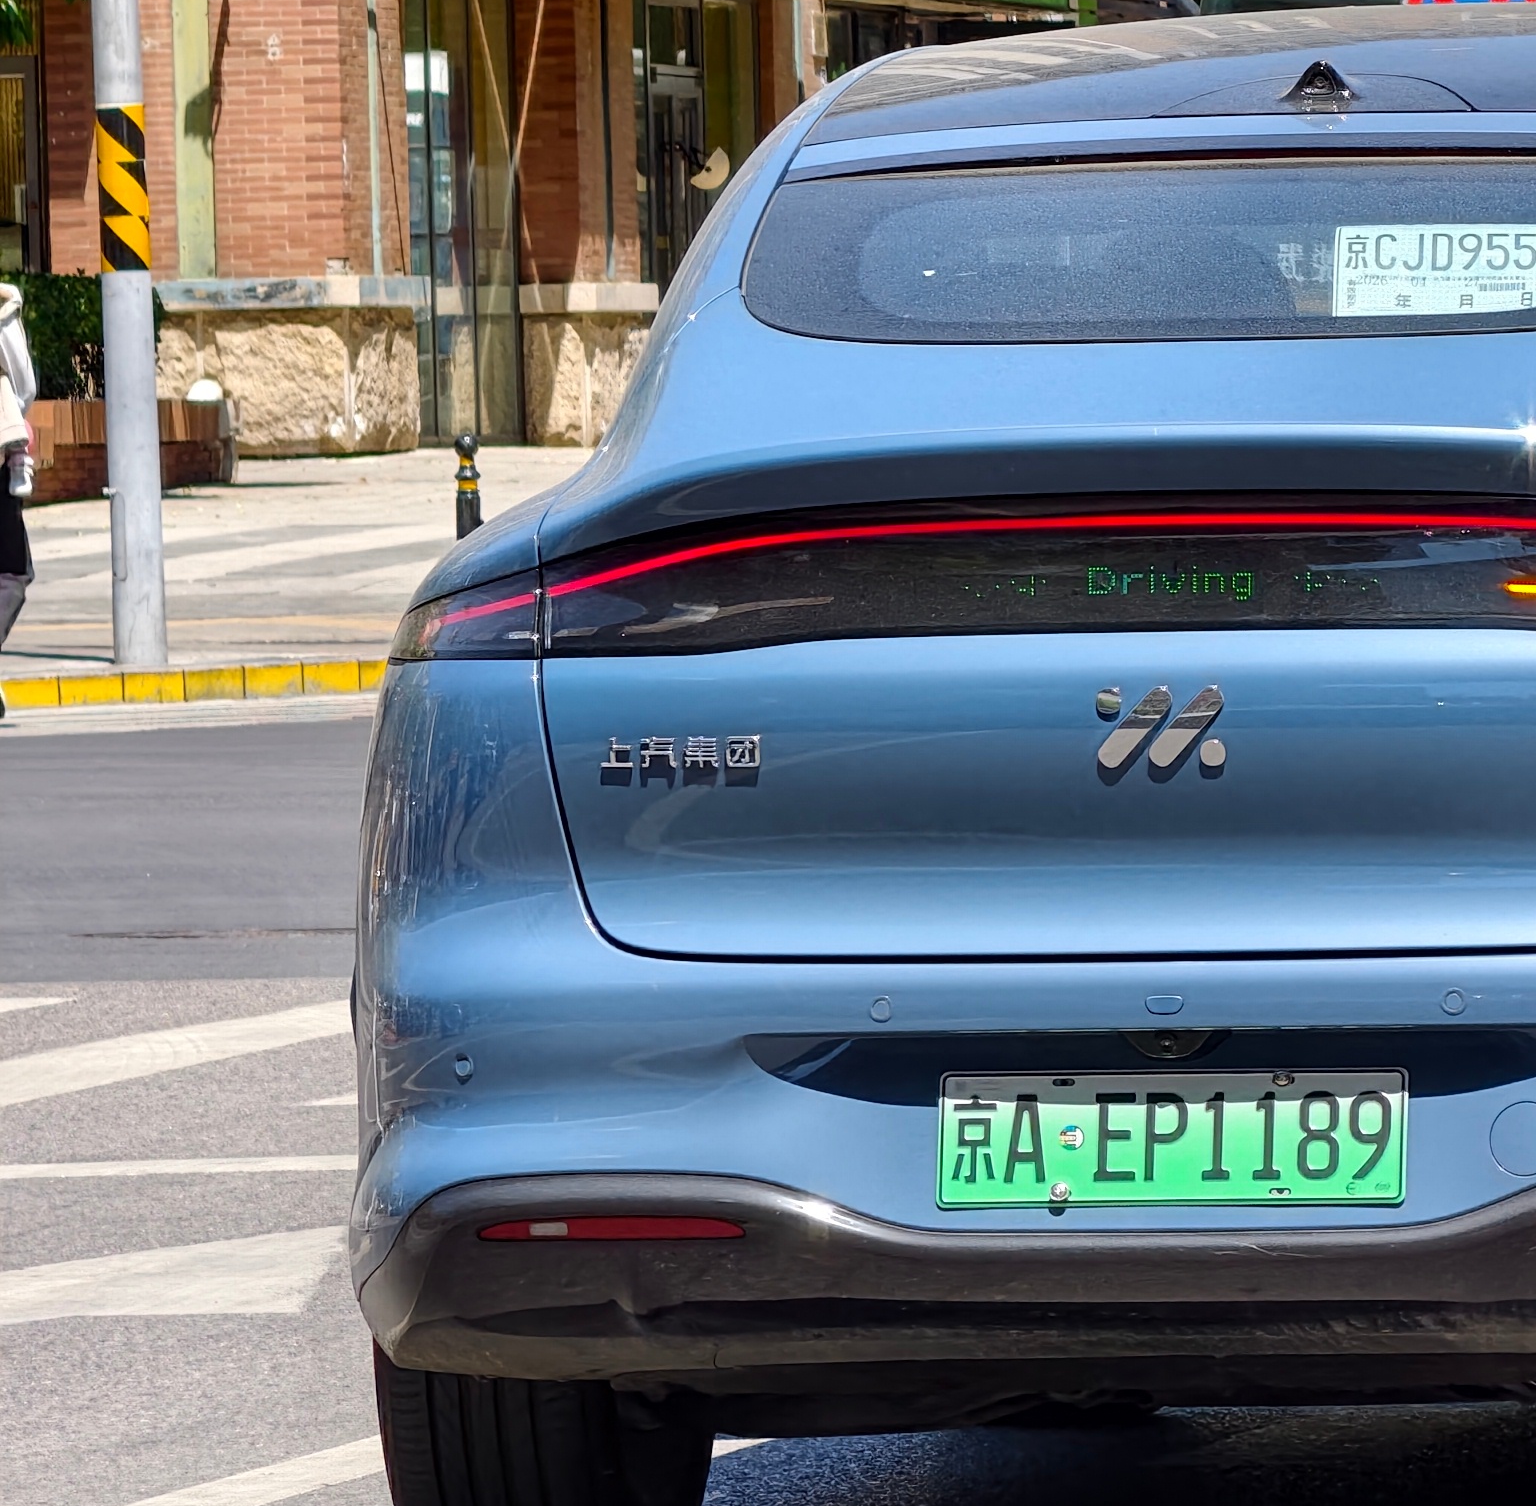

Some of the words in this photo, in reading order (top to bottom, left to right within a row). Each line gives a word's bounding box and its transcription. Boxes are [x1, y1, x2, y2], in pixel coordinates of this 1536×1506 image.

[1394, 293, 1412, 308] 年
[1459, 294, 1474, 309] 月
[1520, 292, 1533, 307] 日
[1087, 565, 1253, 601] Driving
[600, 734, 762, 768] 上汽集团
